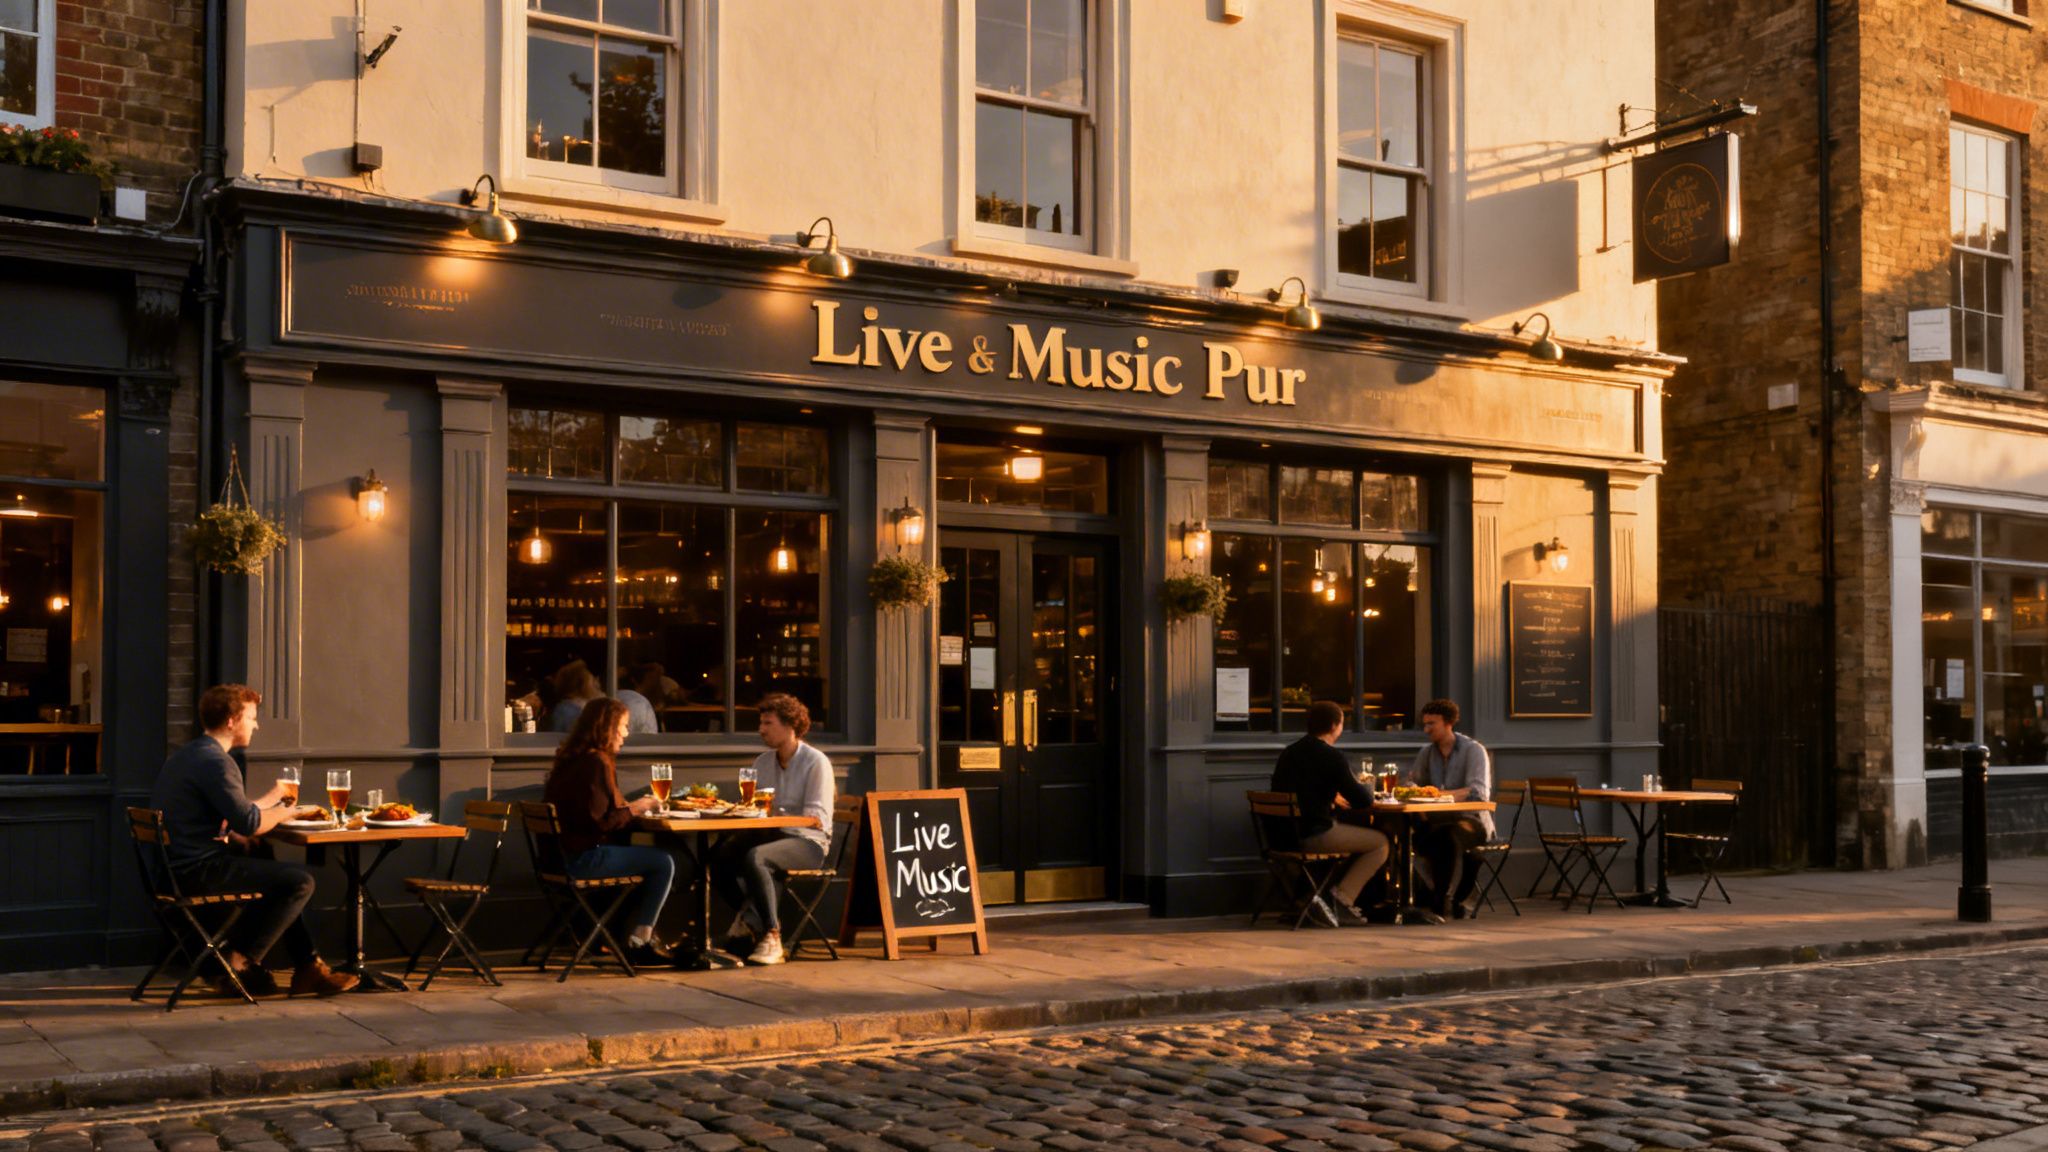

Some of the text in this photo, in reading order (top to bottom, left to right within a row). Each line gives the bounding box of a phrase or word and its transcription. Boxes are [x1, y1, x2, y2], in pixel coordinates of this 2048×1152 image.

[811, 299, 1306, 406] Live & Music Pur
[892, 811, 957, 853] Live
[896, 857, 971, 898] Music
